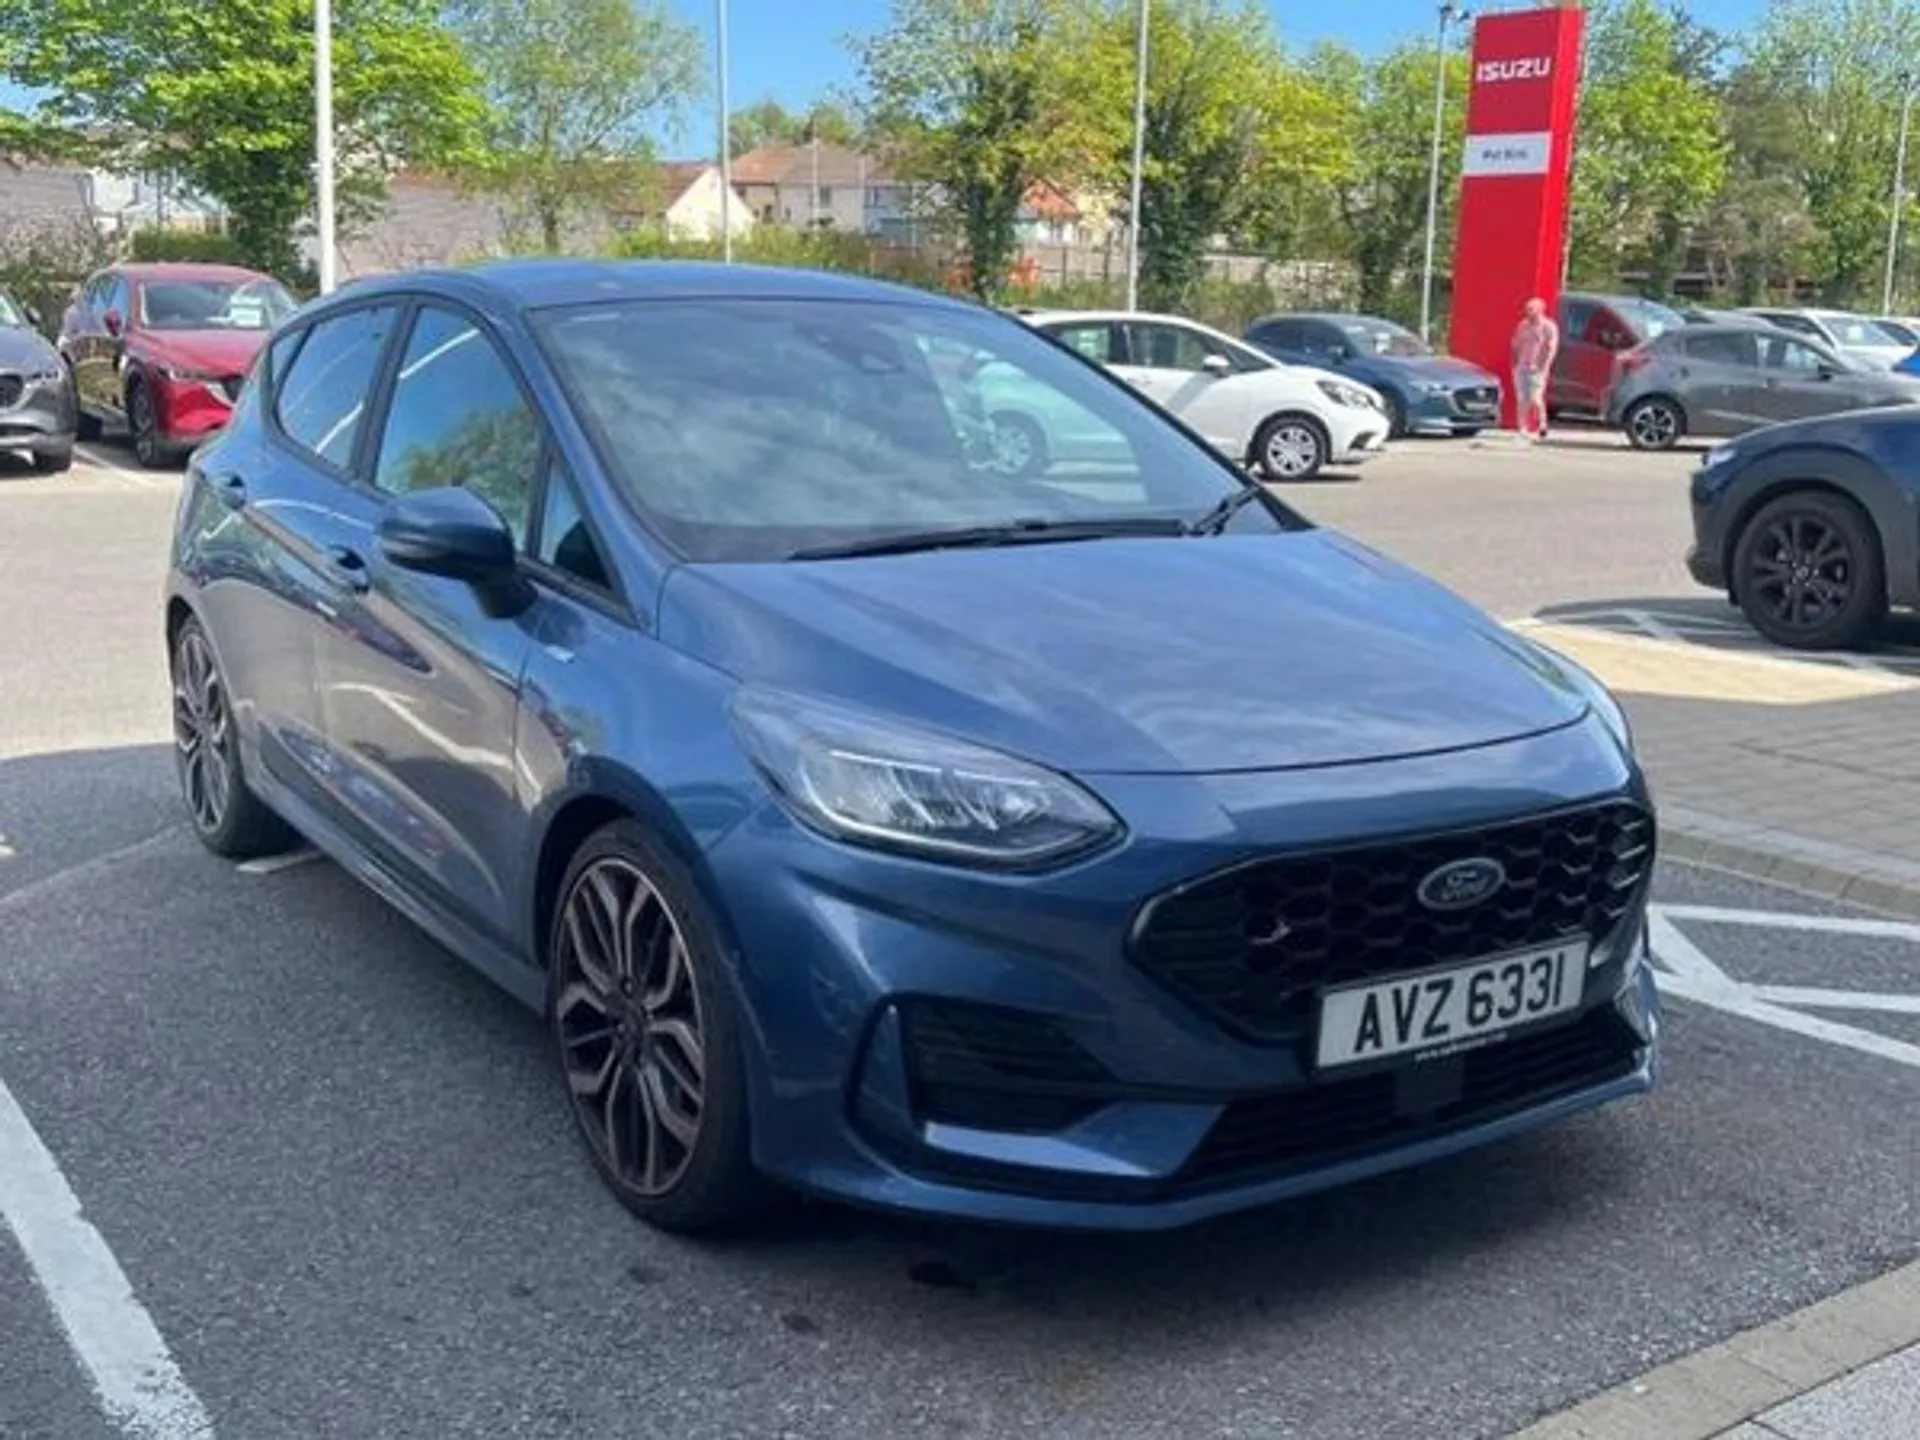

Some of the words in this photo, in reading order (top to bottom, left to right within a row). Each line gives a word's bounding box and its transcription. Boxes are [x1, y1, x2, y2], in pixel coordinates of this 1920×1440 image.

[1475, 57, 1551, 83] ISUZU
[1353, 979, 1455, 1053] AVZ
[1466, 951, 1565, 1027] 6331
